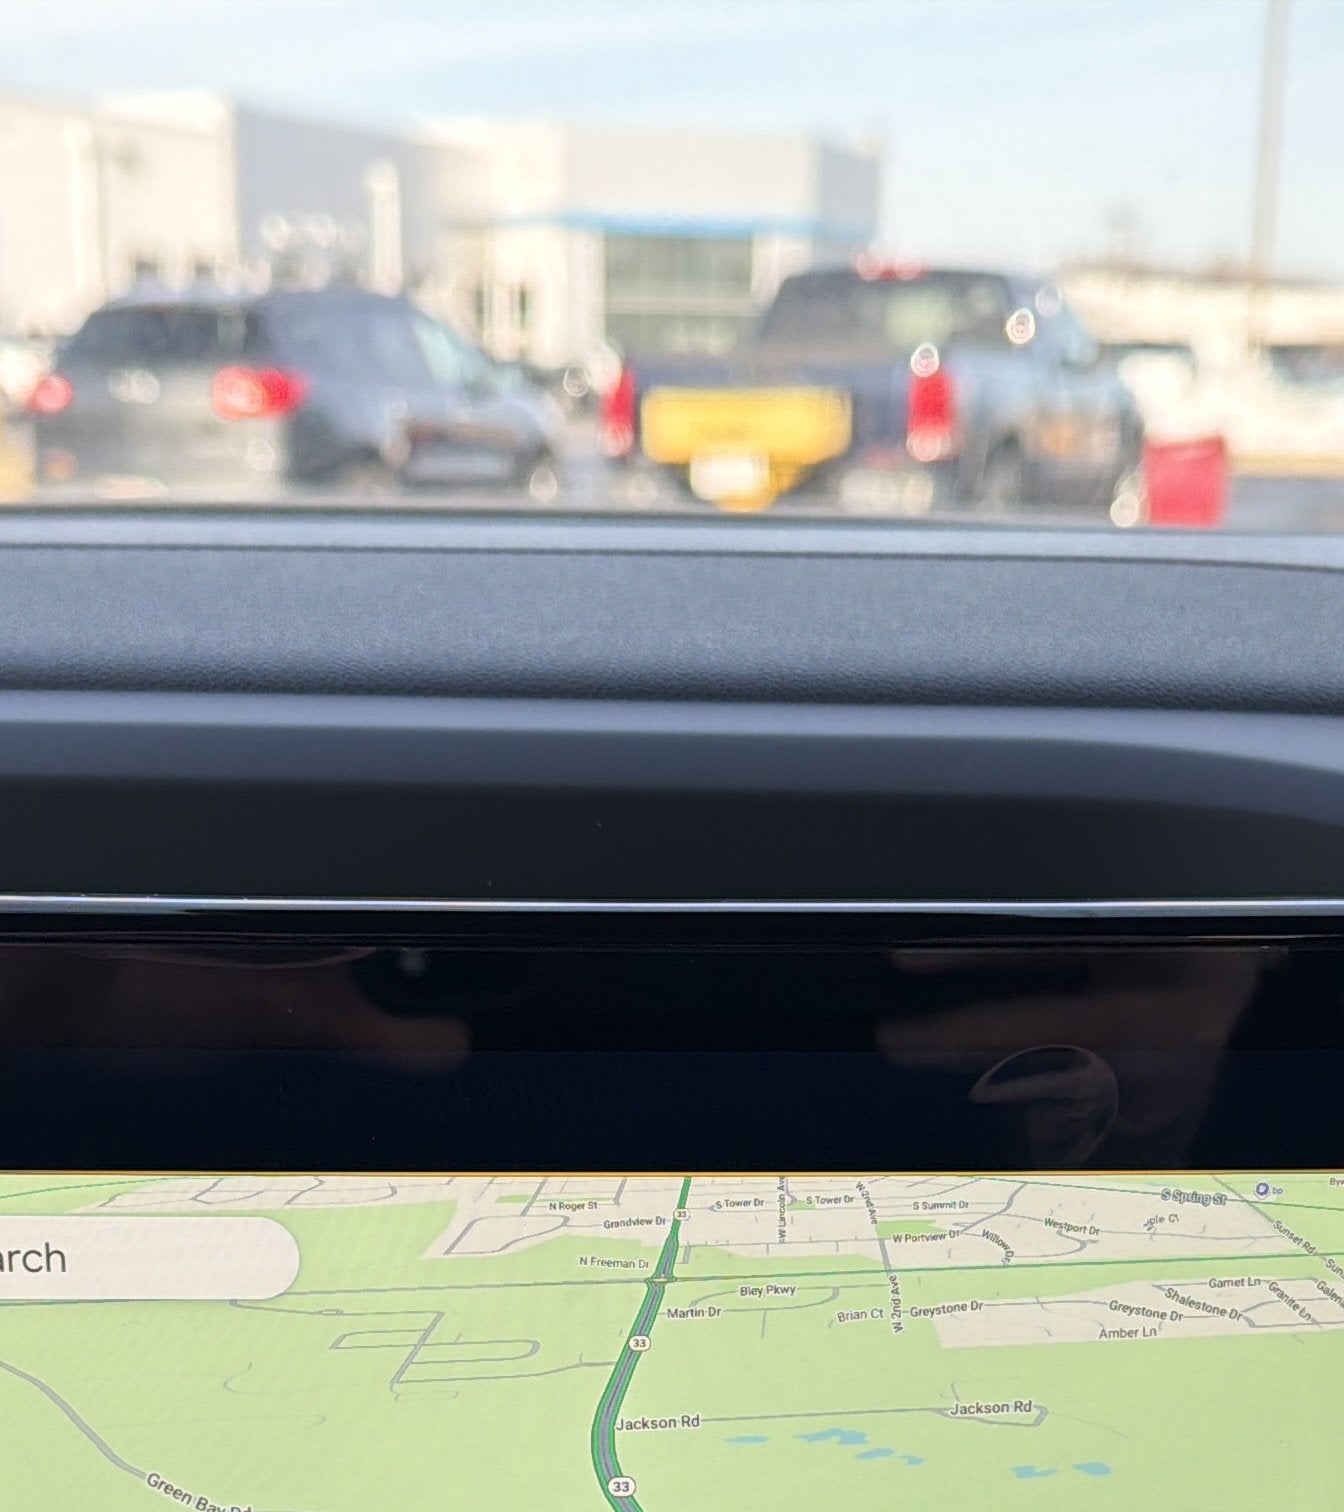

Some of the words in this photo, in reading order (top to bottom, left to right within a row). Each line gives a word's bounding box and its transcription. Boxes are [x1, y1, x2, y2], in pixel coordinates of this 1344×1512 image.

[715, 1200, 723, 1210] S
[724, 1199, 752, 1208] Tower
[753, 1197, 765, 1207] Dr
[806, 1195, 813, 1205] S
[814, 1195, 842, 1205] Tower
[843, 1194, 855, 1204] Dr
[1160, 1188, 1171, 1201] S
[1172, 1188, 1211, 1207] Spring
[549, 1202, 557, 1211] N
[559, 1201, 585, 1212] Roger
[912, 1201, 920, 1211] S
[922, 1201, 957, 1210] Summit
[958, 1200, 969, 1210] Dr
[655, 1216, 667, 1227] Dr
[1044, 1217, 1088, 1235] Westport
[1089, 1225, 1100, 1236] Dr
[893, 1234, 904, 1243] W
[905, 1233, 947, 1244] Portview
[948, 1229, 960, 1239] Dr
[981, 1228, 1011, 1251] Willow
[1272, 1220, 1304, 1246] Sunset
[1303, 1241, 1316, 1254] Rd
[579, 1256, 588, 1267] N
[590, 1257, 636, 1269] Freeman
[638, 1258, 650, 1269] Dr
[888, 1274, 901, 1296] Ave
[1247, 1276, 1262, 1287] Ln
[739, 1286, 764, 1299] Bley
[766, 1284, 797, 1296] Pkwy
[890, 1298, 902, 1319] 2nd
[909, 1303, 968, 1319] Greystone
[970, 1299, 984, 1311] Dr
[1164, 1287, 1227, 1317] Shalestone
[1228, 1308, 1244, 1322] Dr
[1268, 1281, 1300, 1312] Granite
[1298, 1306, 1313, 1322] Ln
[666, 1306, 705, 1319] Martin
[707, 1306, 723, 1317] Dr
[836, 1309, 868, 1323] Brian
[870, 1308, 884, 1319] Ct
[1108, 1299, 1168, 1321] Greystone
[1169, 1310, 1184, 1322] Dr
[891, 1321, 904, 1334] W
[1098, 1326, 1139, 1340] Amber
[1142, 1325, 1157, 1337] Ln
[632, 1337, 647, 1350] 33
[949, 1400, 1008, 1416] Jackson
[1011, 1398, 1033, 1414] Rd
[615, 1416, 677, 1432] Jackson
[680, 1413, 701, 1428] Rd
[146, 1472, 193, 1506] Green
[612, 1481, 630, 1492] 33
